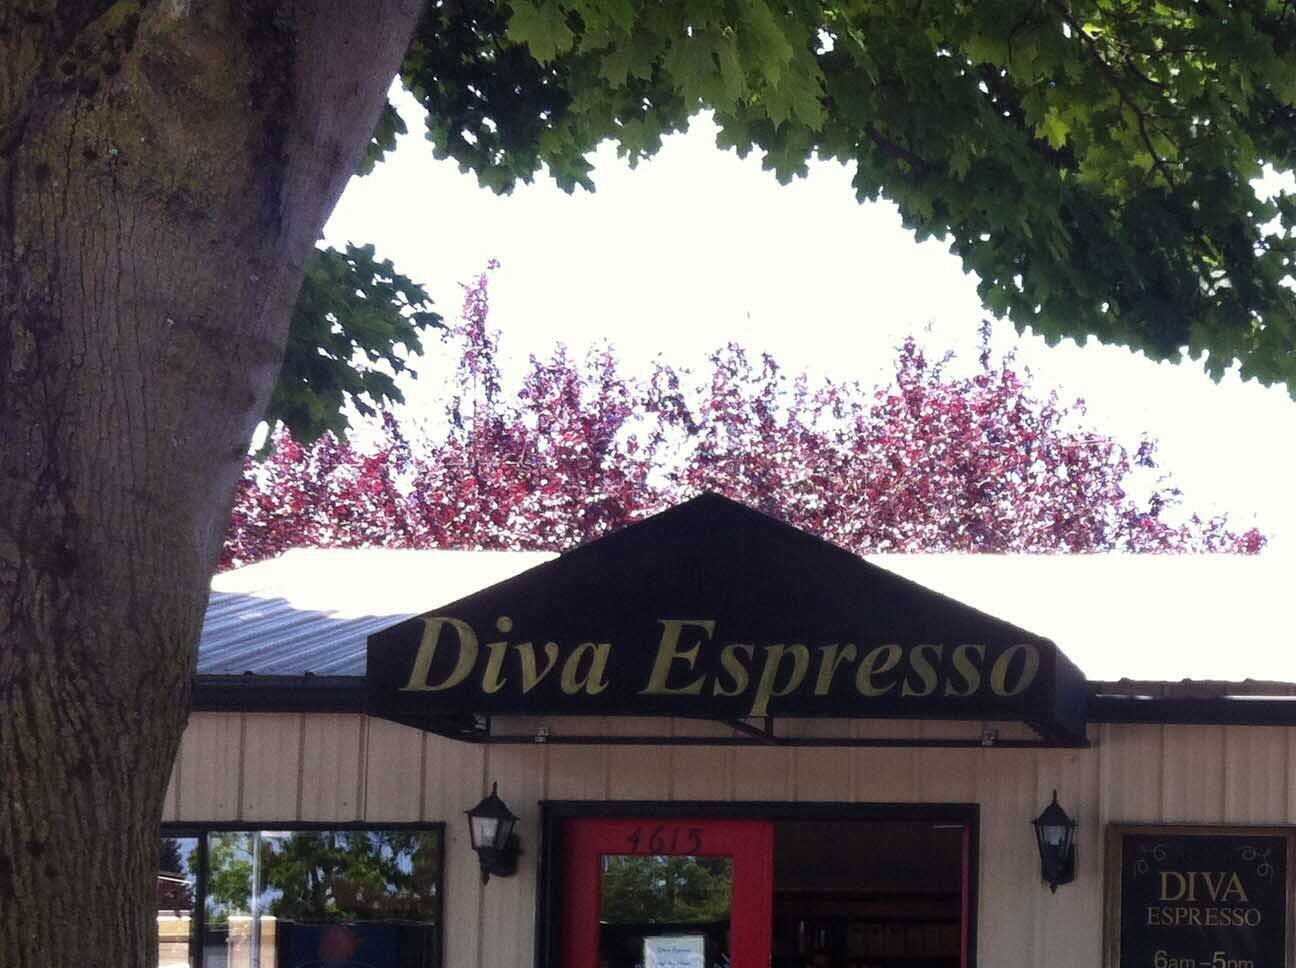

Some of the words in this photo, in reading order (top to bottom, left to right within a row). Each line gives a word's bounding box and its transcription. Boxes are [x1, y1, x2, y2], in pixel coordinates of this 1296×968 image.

[401, 616, 611, 695] Diva
[638, 618, 1040, 717] Espresso
[626, 825, 704, 854] 4615
[1158, 871, 1249, 901] DIVA
[1146, 906, 1261, 927] ESPRESSO
